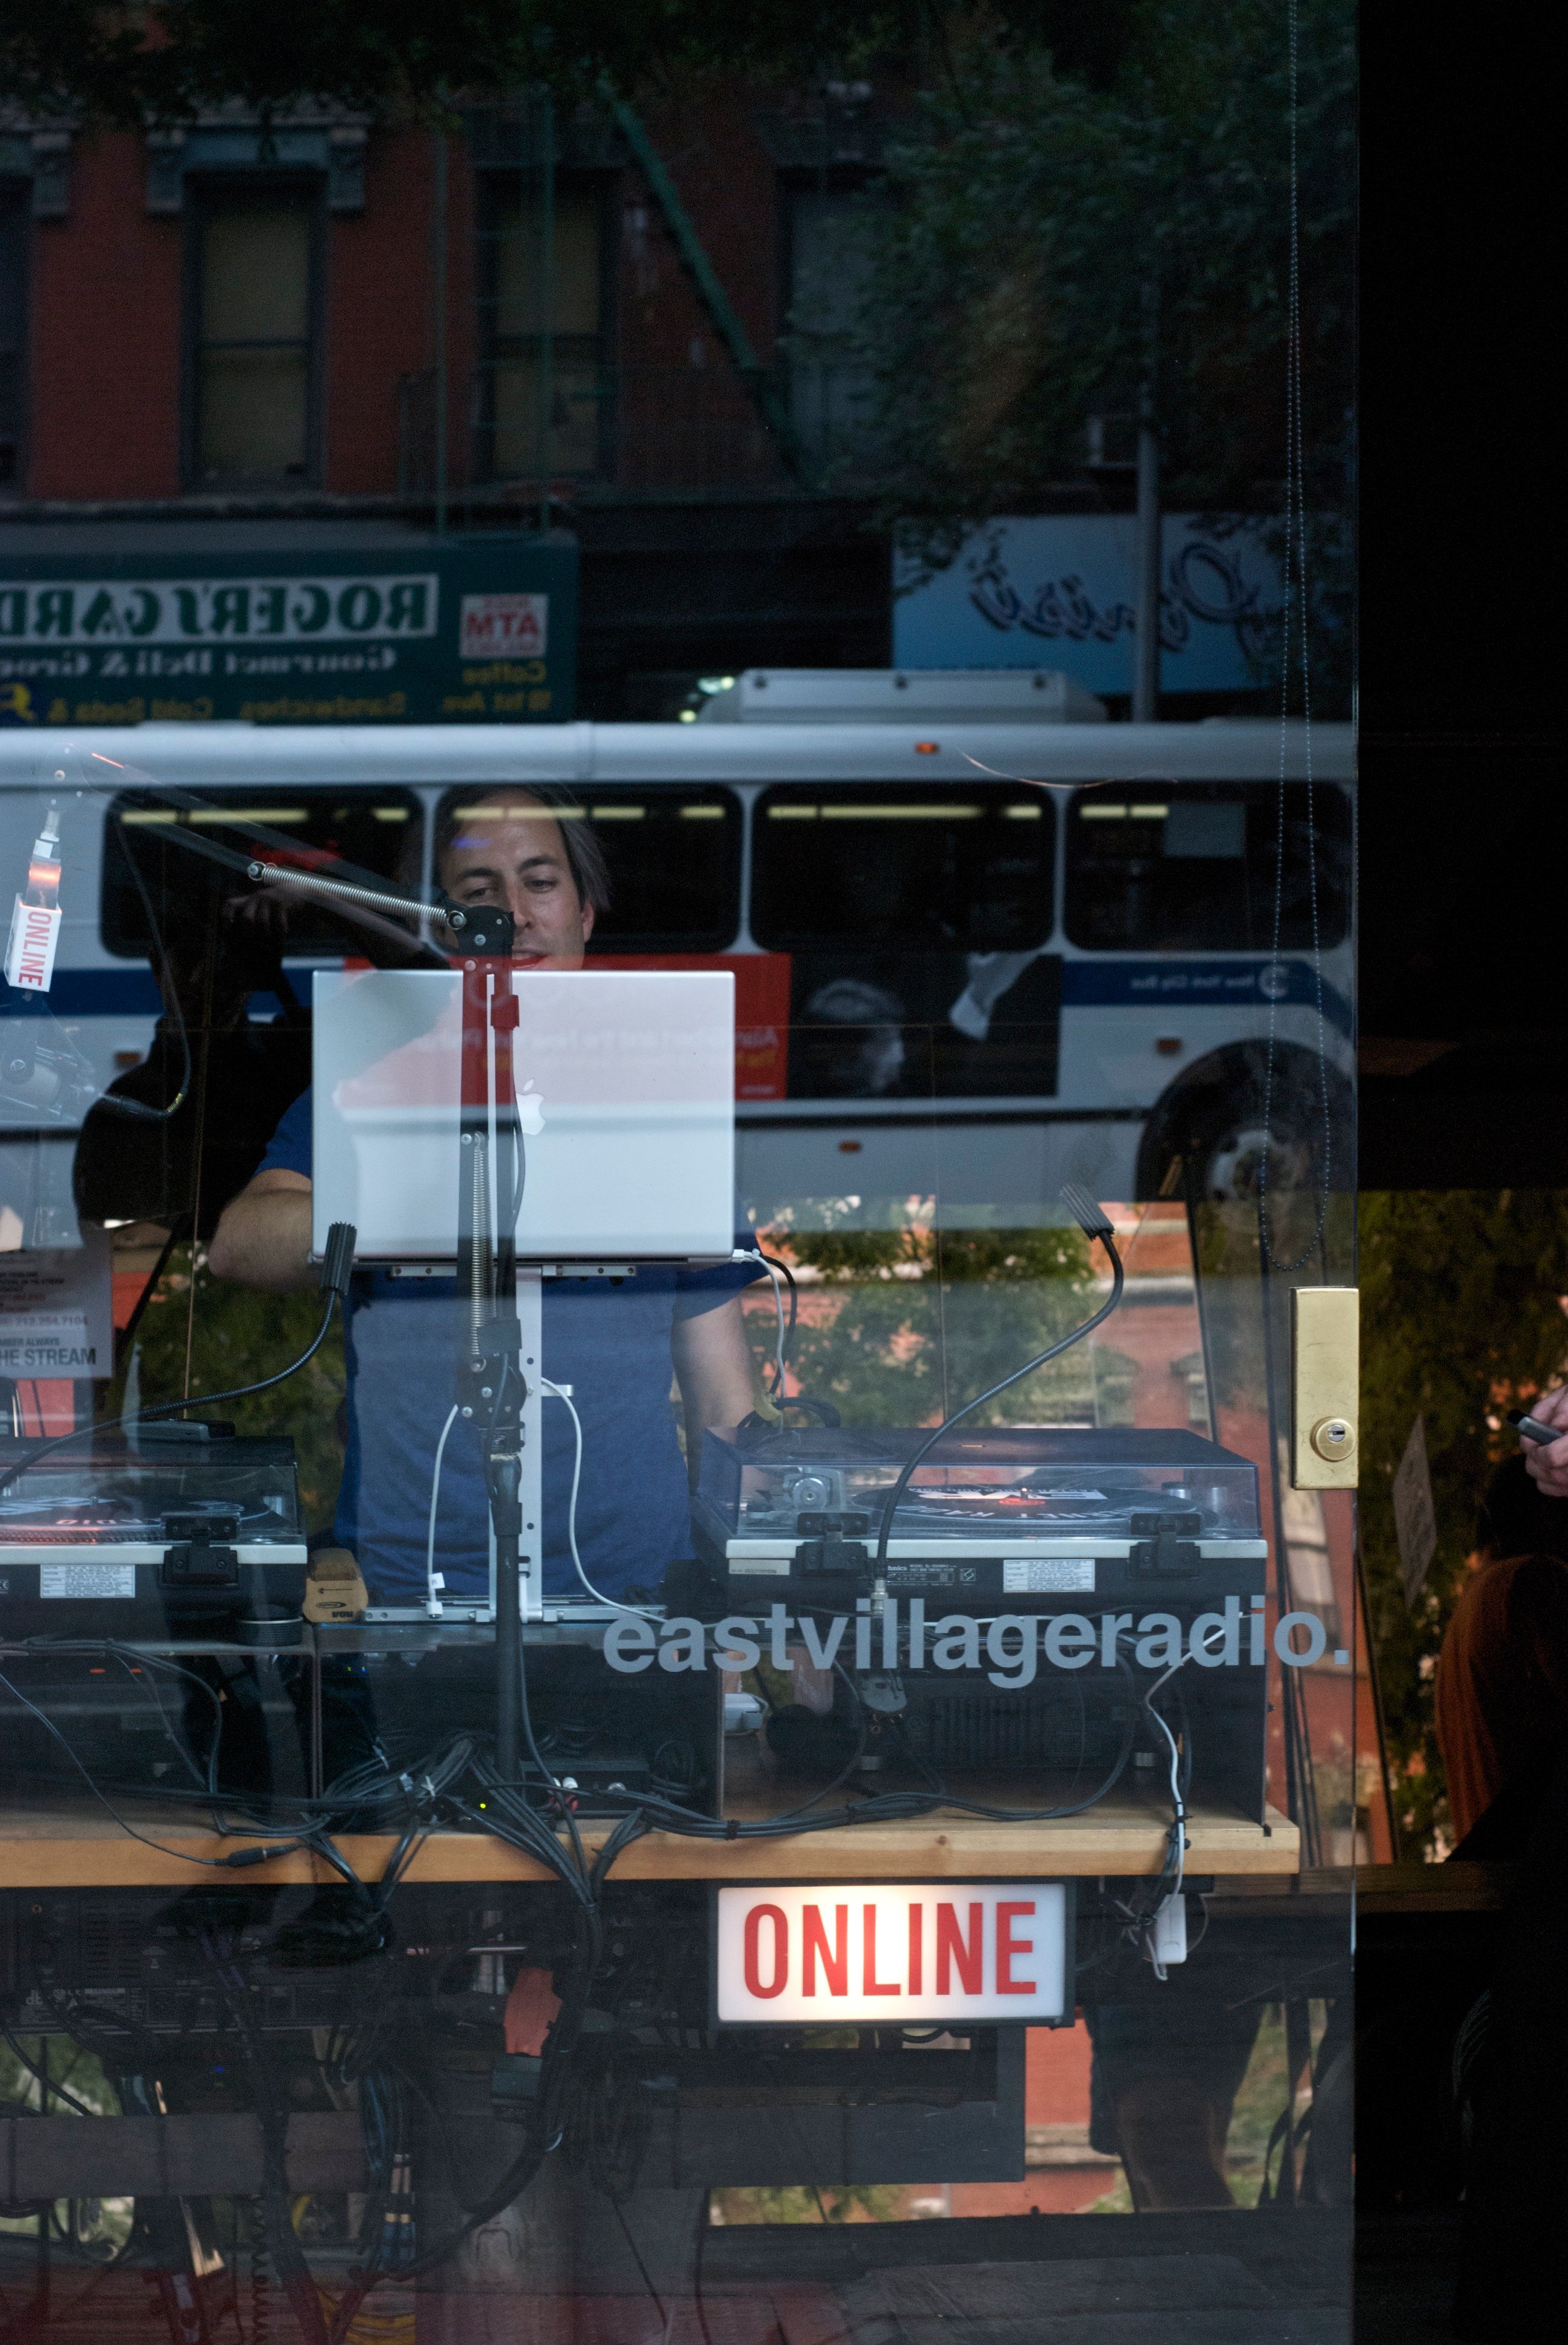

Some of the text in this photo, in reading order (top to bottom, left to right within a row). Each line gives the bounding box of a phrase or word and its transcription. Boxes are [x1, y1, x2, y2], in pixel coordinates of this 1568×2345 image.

[18, 911, 52, 987] ONLINE
[25, 1347, 96, 1366] STREAM
[603, 1595, 1350, 1688] eastvillageradio.
[744, 1902, 1037, 1999] ONLINE
